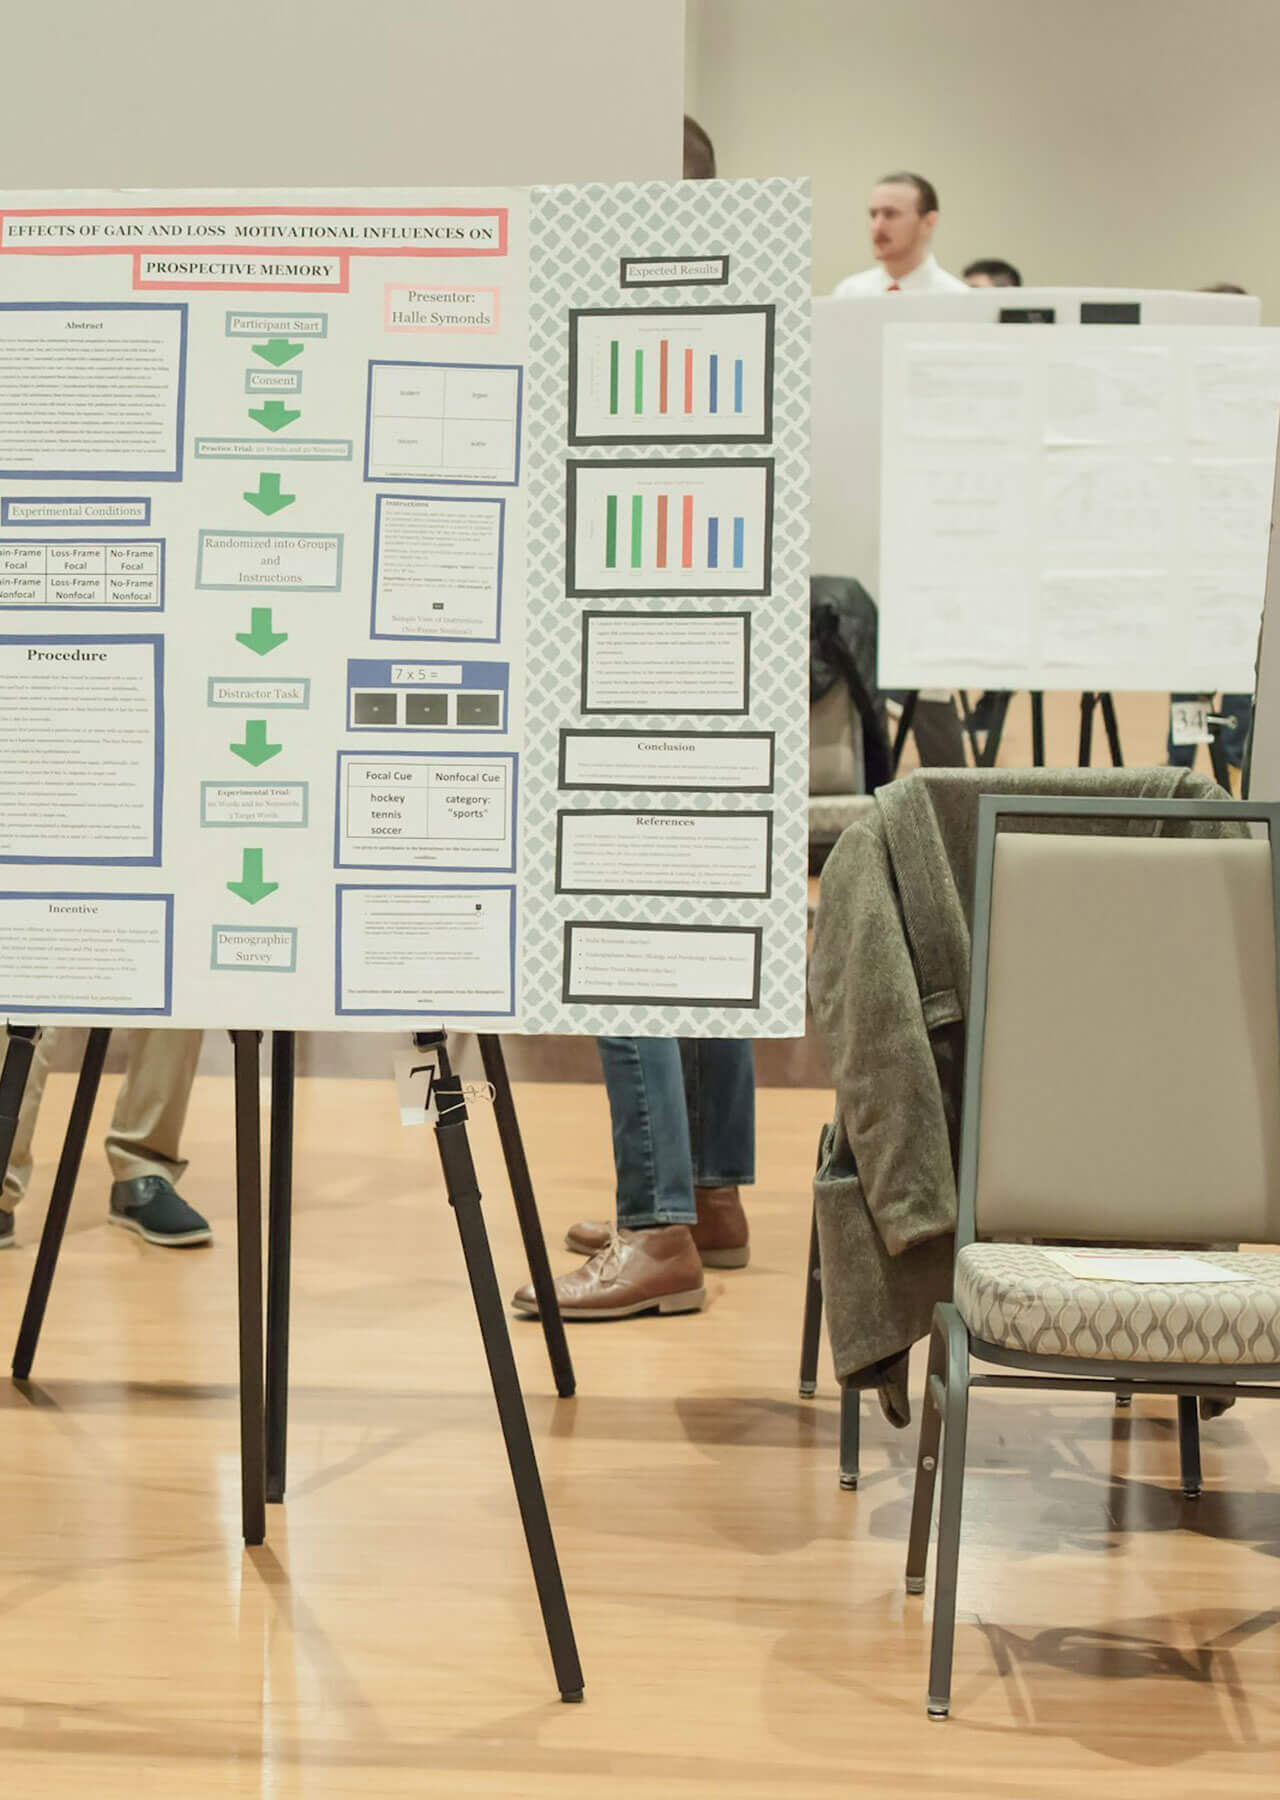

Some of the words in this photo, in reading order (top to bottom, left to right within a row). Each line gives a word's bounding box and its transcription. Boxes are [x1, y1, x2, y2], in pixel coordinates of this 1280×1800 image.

[8, 224, 75, 237] EFFECTS
[79, 224, 101, 237] OF
[104, 224, 144, 237] GAIN
[148, 224, 183, 237] AND
[186, 224, 226, 237] LOSS
[234, 225, 359, 239] MOTIVATIONAL
[363, 227, 465, 239] INFLUENCES
[469, 228, 493, 240] ON
[146, 261, 257, 276] PROSPECTIVE
[259, 264, 334, 277] MEMORY
[628, 266, 677, 279] Expected
[680, 264, 719, 276] Results
[408, 290, 476, 304] Presentor:
[392, 311, 427, 324] Halle
[430, 311, 491, 327] Symonds
[64, 321, 104, 330] Abstract
[233, 318, 291, 332] Participant
[293, 320, 320, 331] Start
[251, 375, 295, 386] Consent
[12, 506, 83, 518] Experimental
[84, 506, 142, 517] Conditions
[205, 537, 271, 549] Randomized
[274, 538, 295, 549] into
[297, 539, 337, 552] Groups
[50, 549, 101, 558] Loss-Frame
[110, 549, 153, 558] No-Frame
[4, 561, 28, 569] Focal
[64, 562, 88, 570] Focal
[121, 562, 144, 571] Focal
[260, 555, 281, 566] and
[50, 578, 100, 587] Loss-Frame
[110, 579, 153, 588] No-Frame
[239, 572, 303, 584] Instructions
[56, 591, 95, 600] Nonfocal
[112, 592, 152, 601] Nonfocal
[27, 649, 108, 662] Procedure
[394, 668, 402, 681] 7
[407, 671, 414, 681] x
[418, 669, 426, 681] 5
[218, 688, 272, 699] Distractor
[274, 689, 300, 699] Task
[637, 741, 696, 752] Conclusion
[365, 771, 392, 780] Focal
[393, 772, 413, 781] Cue
[435, 772, 480, 783] Nonfocal
[481, 773, 501, 783] Cue
[370, 793, 406, 804] hockey
[445, 795, 492, 805] category:
[371, 811, 402, 820] tennis
[636, 816, 696, 827] References
[370, 826, 403, 836] soccer
[48, 903, 99, 915] Incentive
[219, 934, 290, 947] Demographic
[235, 951, 273, 964] Survey
